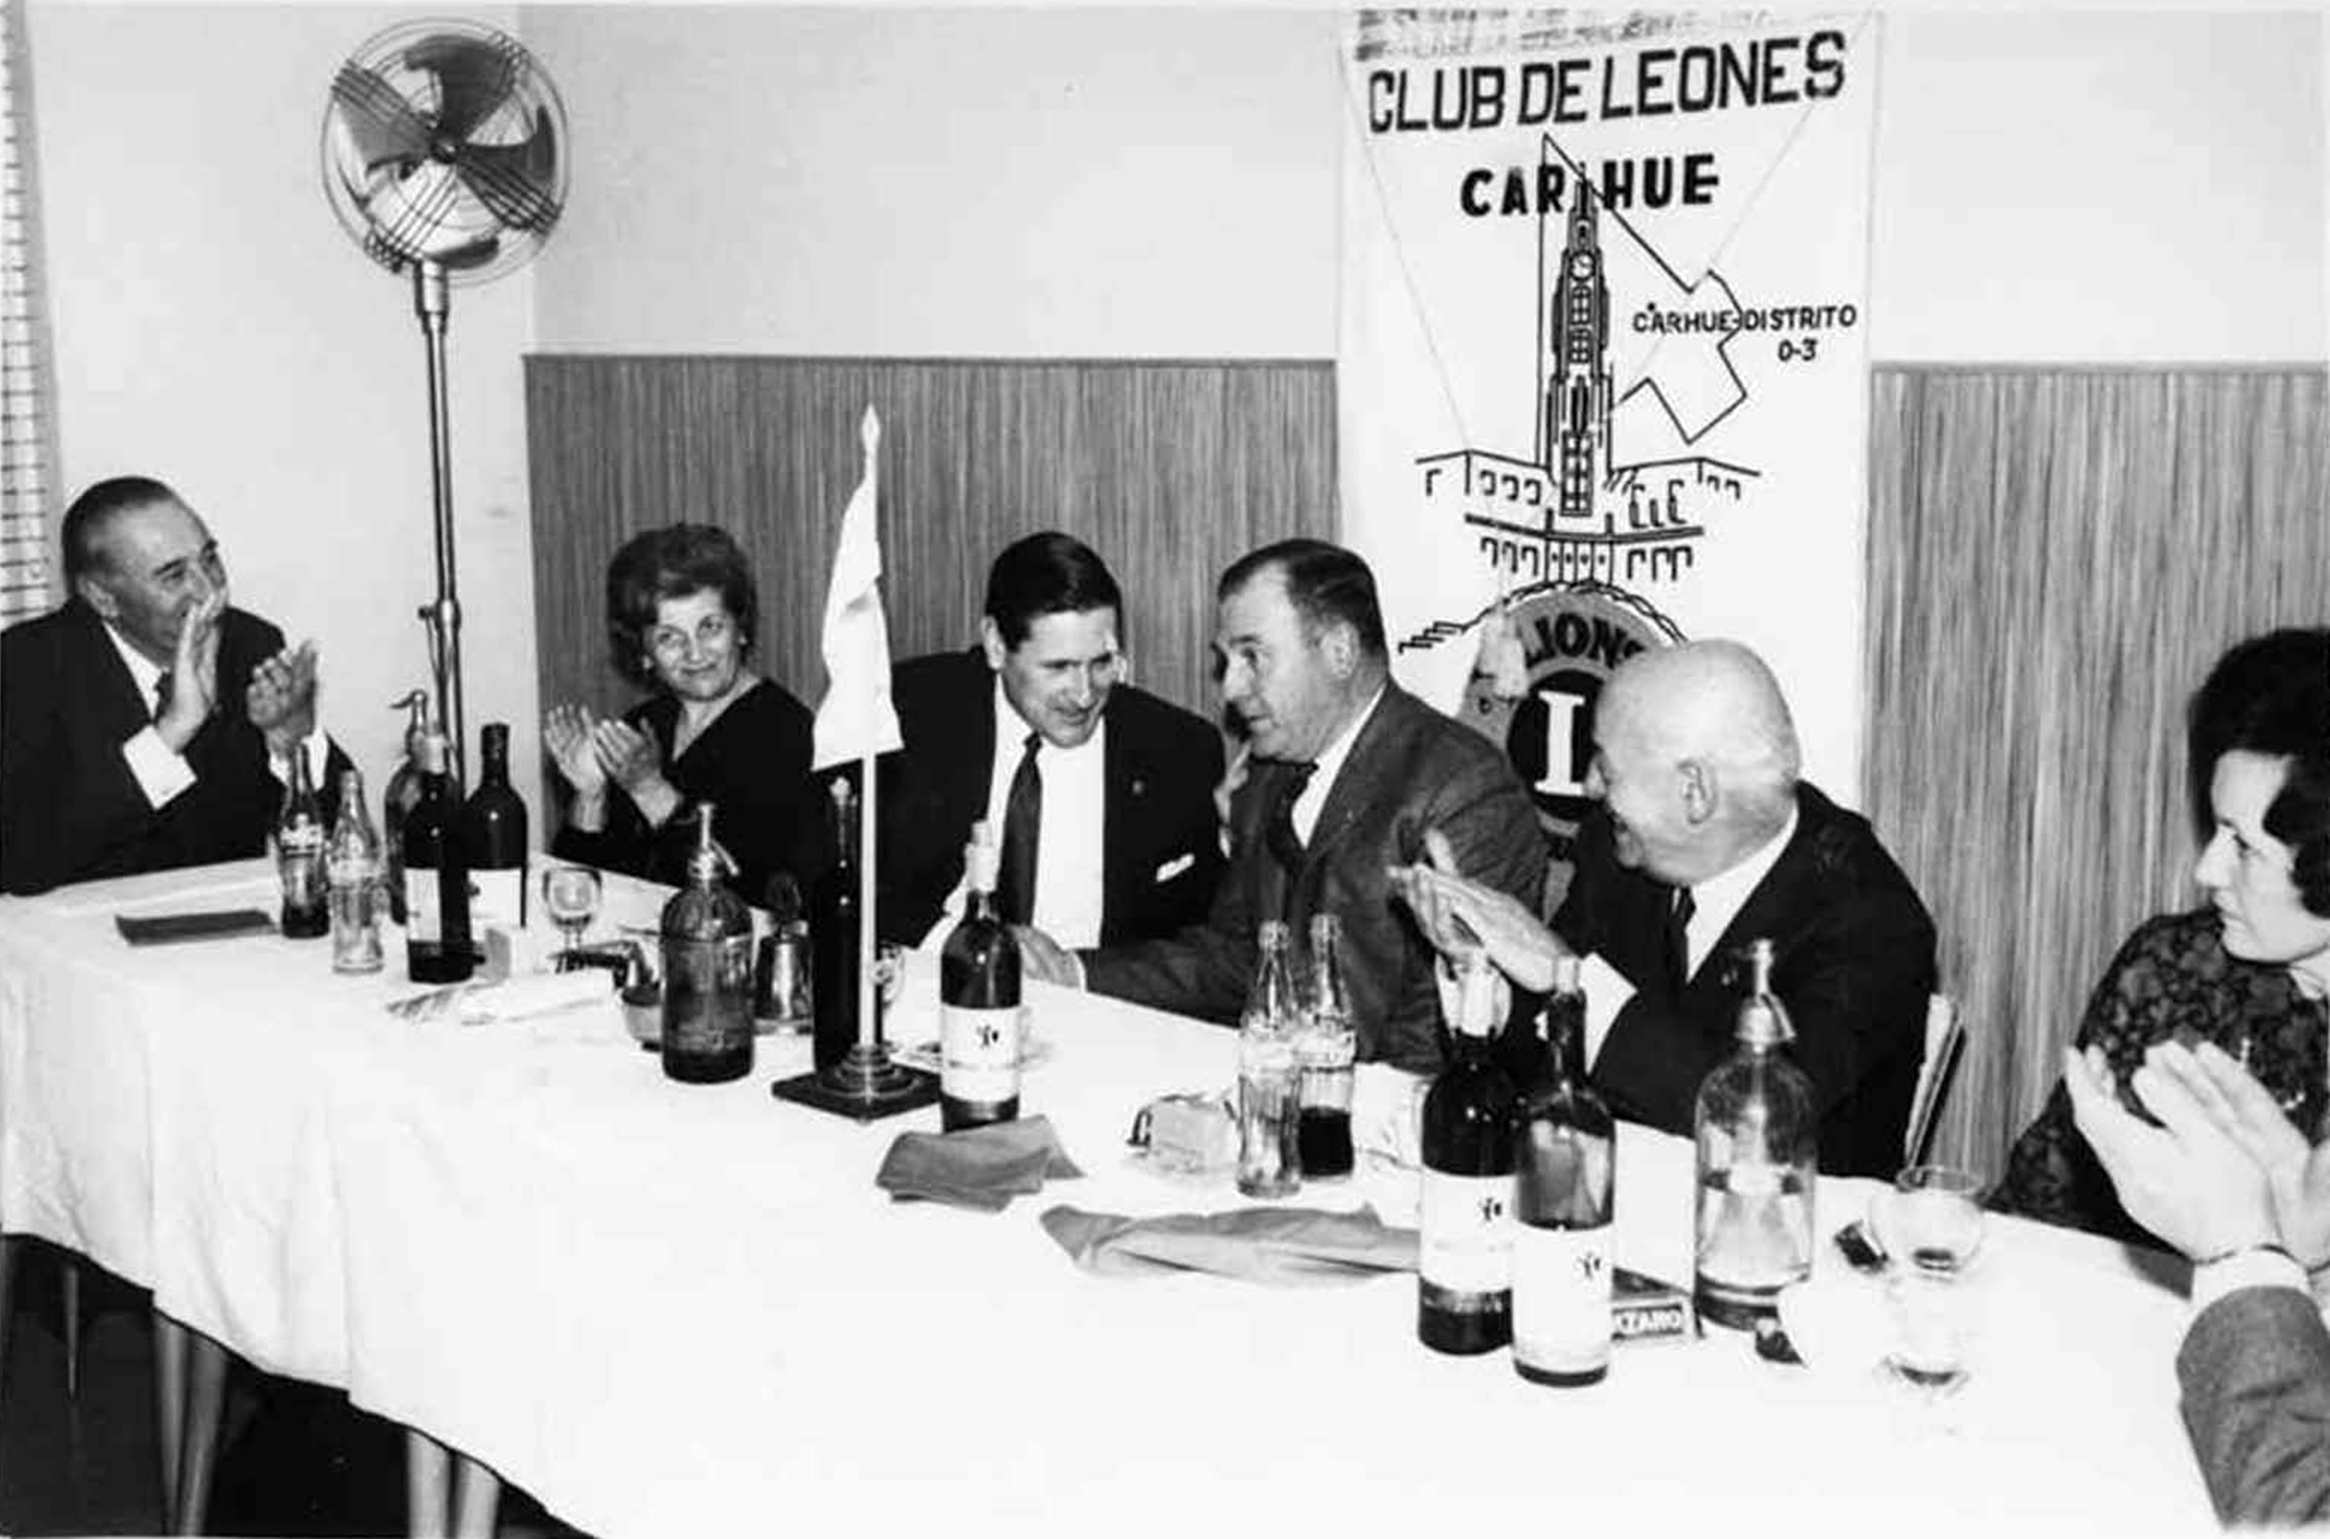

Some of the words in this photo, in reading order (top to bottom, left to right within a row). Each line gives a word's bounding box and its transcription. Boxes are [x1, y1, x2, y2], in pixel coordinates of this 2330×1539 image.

[1369, 66, 1505, 133] CLUB
[1516, 59, 1591, 125] DE
[1600, 30, 1845, 119] LEONES
